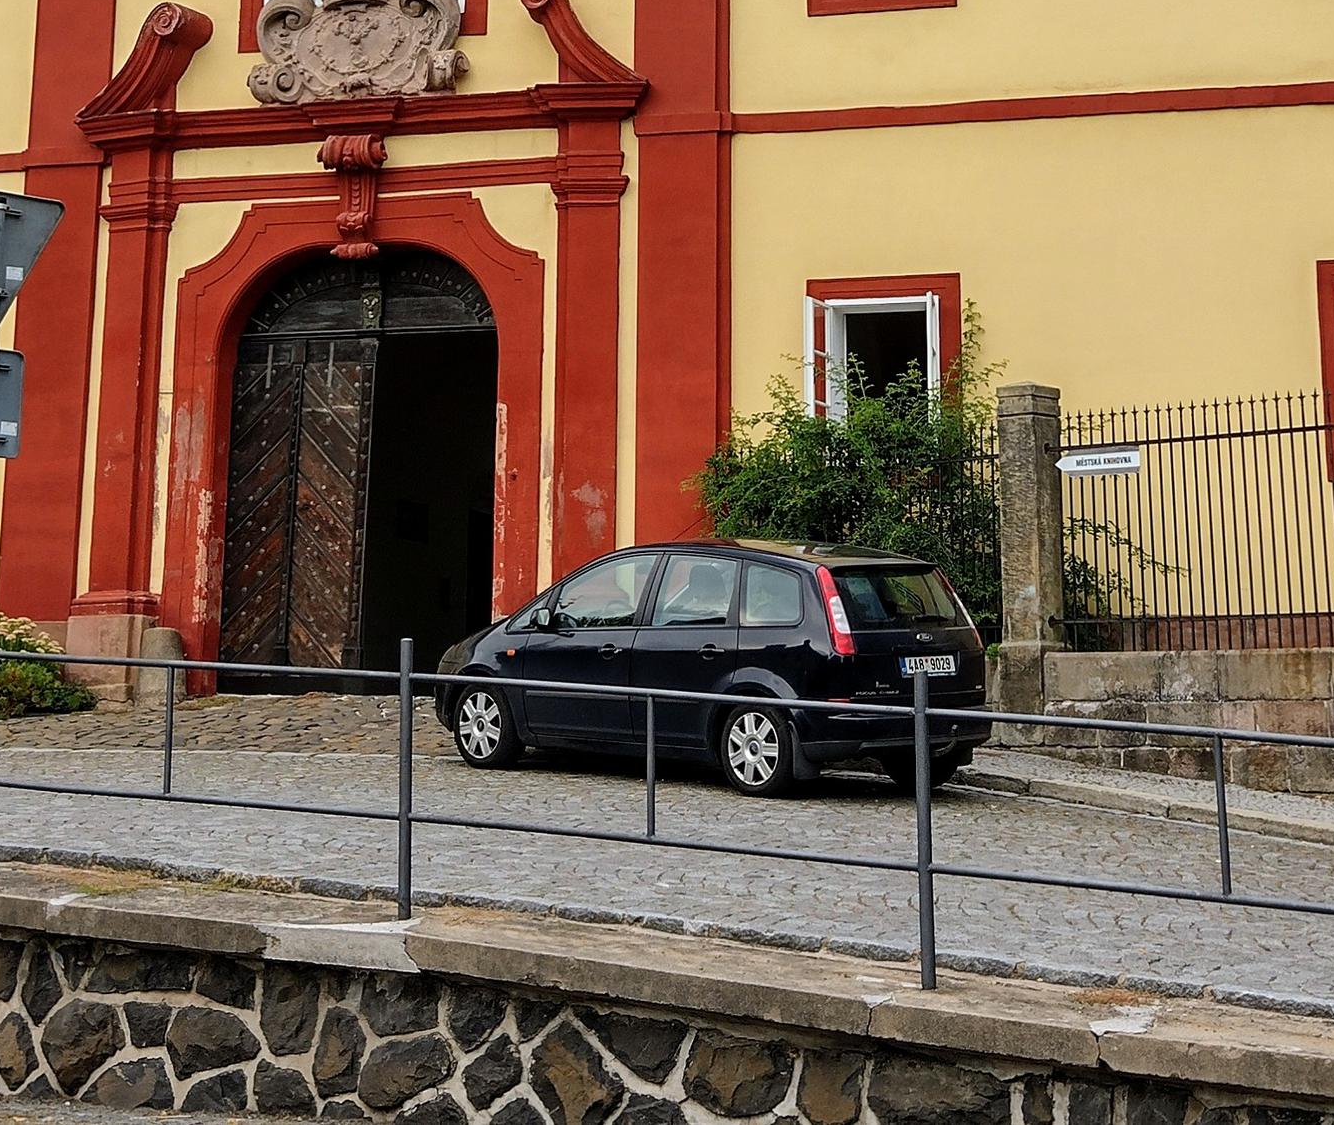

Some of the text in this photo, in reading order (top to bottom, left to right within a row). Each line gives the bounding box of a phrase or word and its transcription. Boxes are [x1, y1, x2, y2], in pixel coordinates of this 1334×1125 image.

[1075, 456, 1132, 467] MĚSTSKÁ KNIHOVNA
[930, 657, 951, 670] 9029
